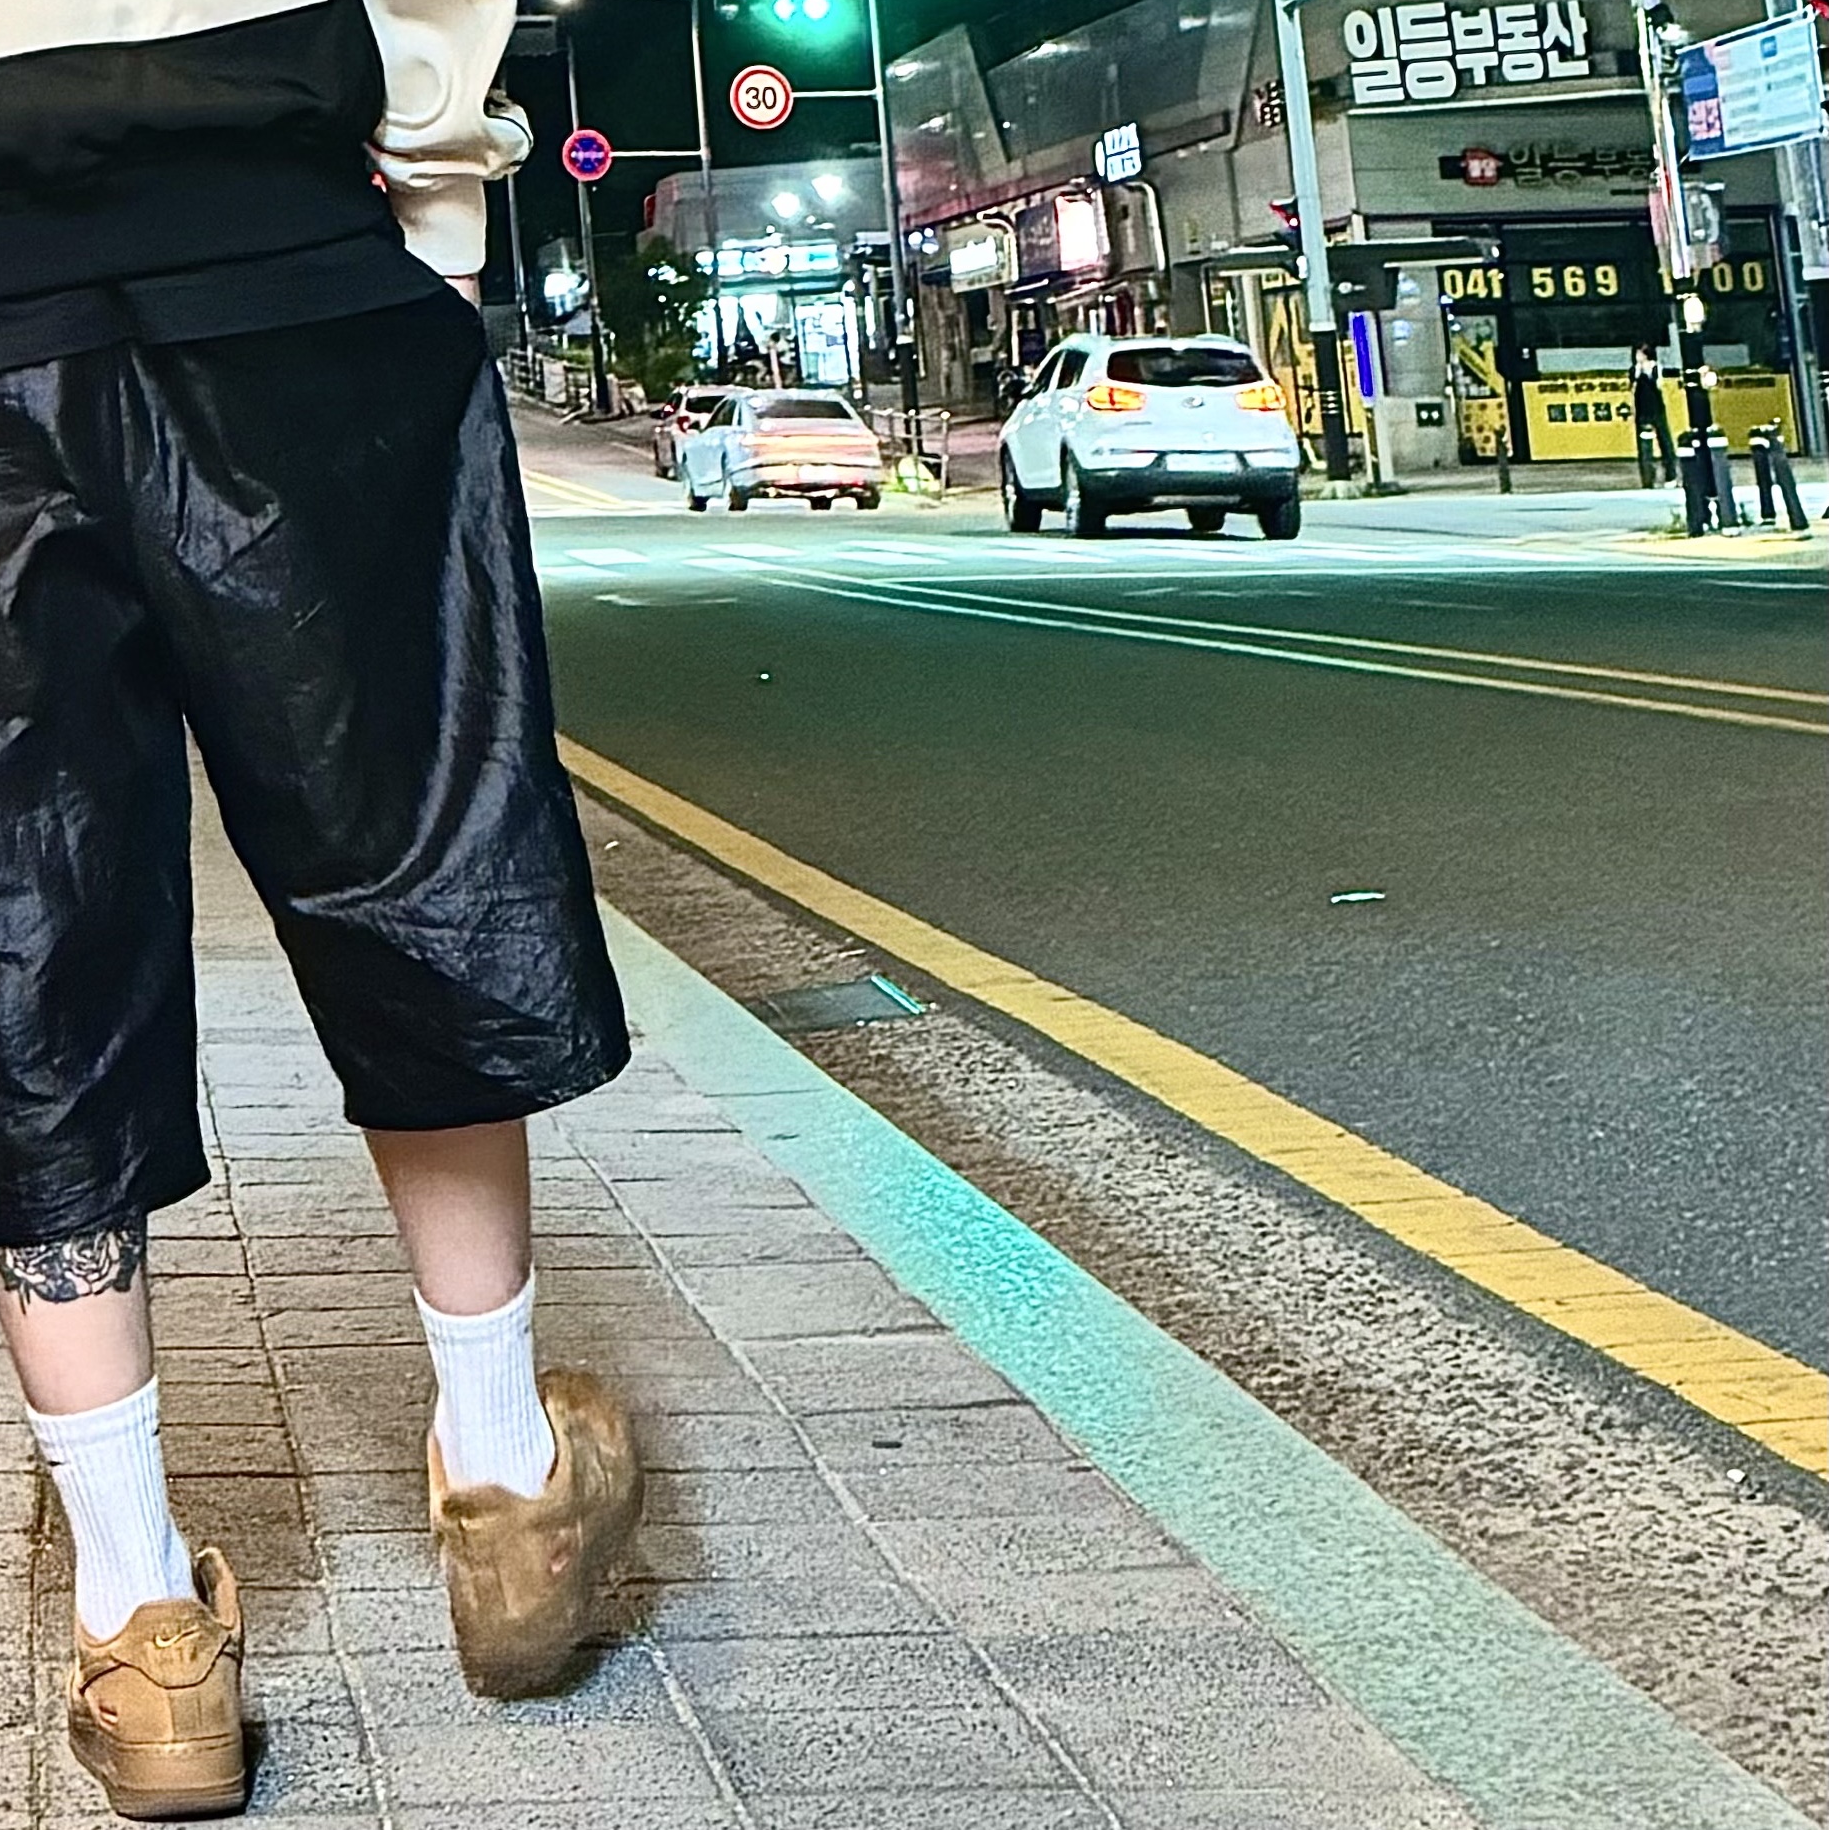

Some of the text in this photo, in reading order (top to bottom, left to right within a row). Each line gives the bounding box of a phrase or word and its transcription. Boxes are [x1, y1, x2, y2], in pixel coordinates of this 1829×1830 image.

[1343, 0, 1590, 105] 일등부동산
[745, 86, 777, 110] 30
[1508, 142, 1654, 188] 일등부동
[1443, 269, 1503, 299] 041
[1531, 265, 1619, 298] 569
